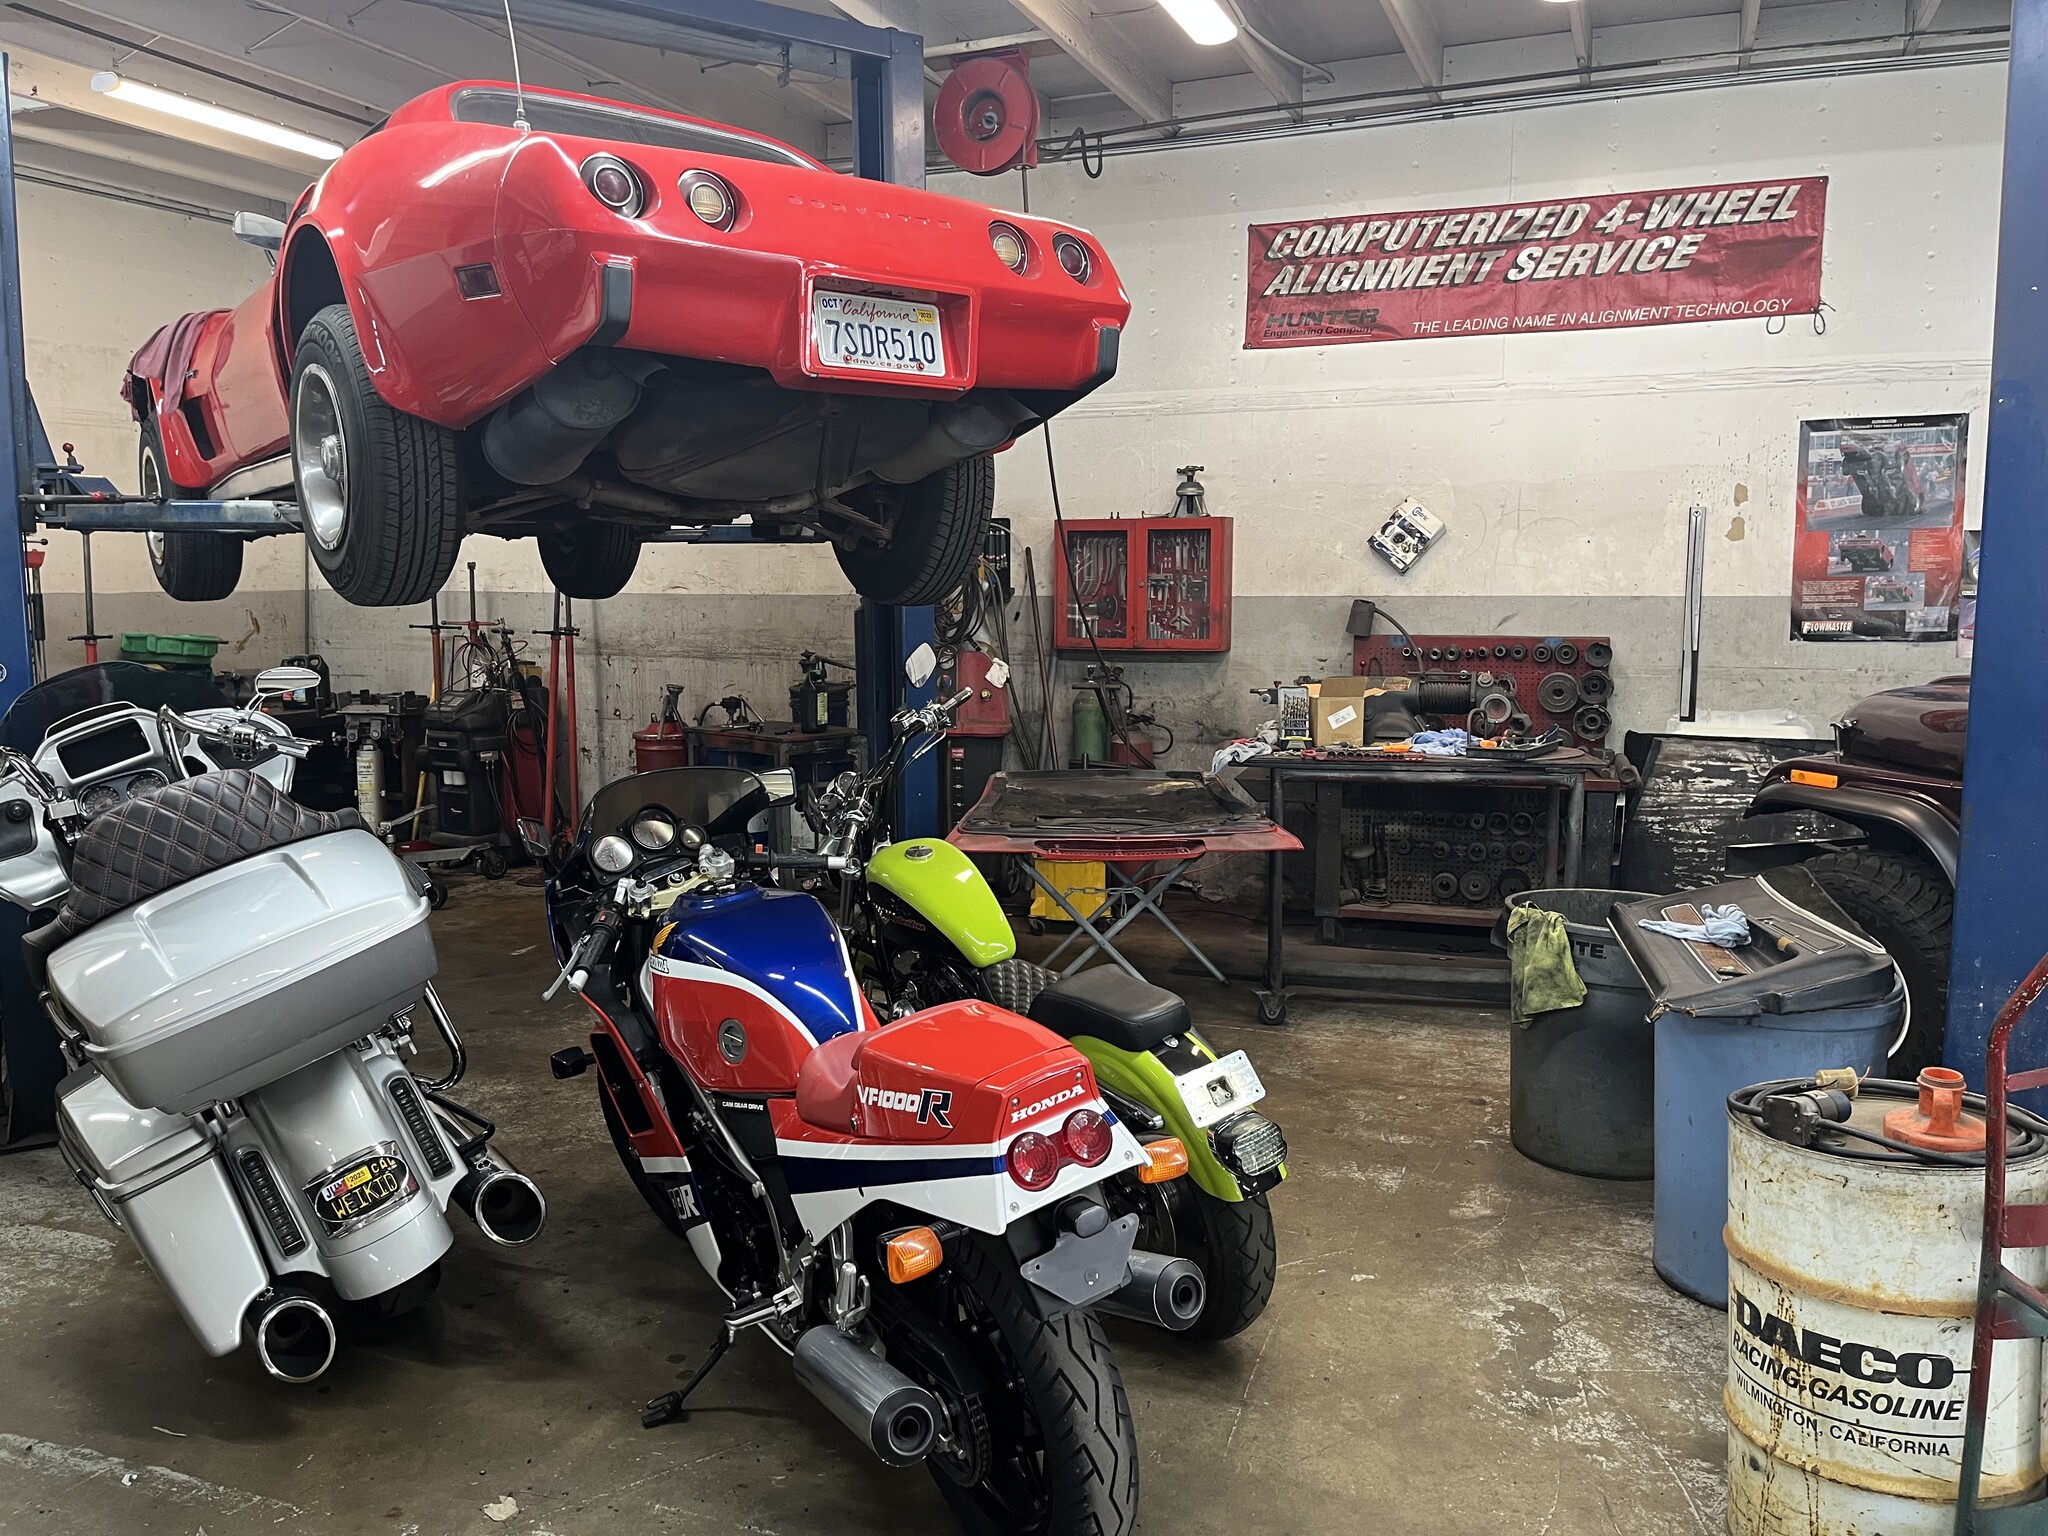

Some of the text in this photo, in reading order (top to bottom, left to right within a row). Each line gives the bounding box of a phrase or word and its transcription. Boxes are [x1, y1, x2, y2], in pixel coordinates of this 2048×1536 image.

[1265, 185, 1802, 260] COMPUTERIZED 4-WHEEL
[1261, 233, 1707, 297] ALIGNMENT SERVICE
[822, 298, 838, 309] OCT
[842, 299, 917, 323] California
[1265, 308, 1380, 328] HUNTER
[1412, 298, 1793, 334] THE LEADING NAME IN ALIGNMENT TECHNOLOGY
[824, 319, 937, 364] 7SDR510
[1263, 325, 1376, 339] Engineering Company
[852, 358, 915, 369] dmv.ca.gov
[1803, 621, 1852, 634] FLOWMASTER
[748, 1103, 764, 1111] DRIVE
[1011, 1085, 1086, 1124] HONDA
[350, 1170, 366, 1182] 2025
[371, 1157, 397, 1173] CAL
[331, 1173, 398, 1219] WEIKID
[1736, 1292, 1953, 1389] DAECO
[1733, 1329, 1964, 1421] RACING GASOLINE
[1735, 1370, 1950, 1456] WILMINGTON, CALIFORNIA
